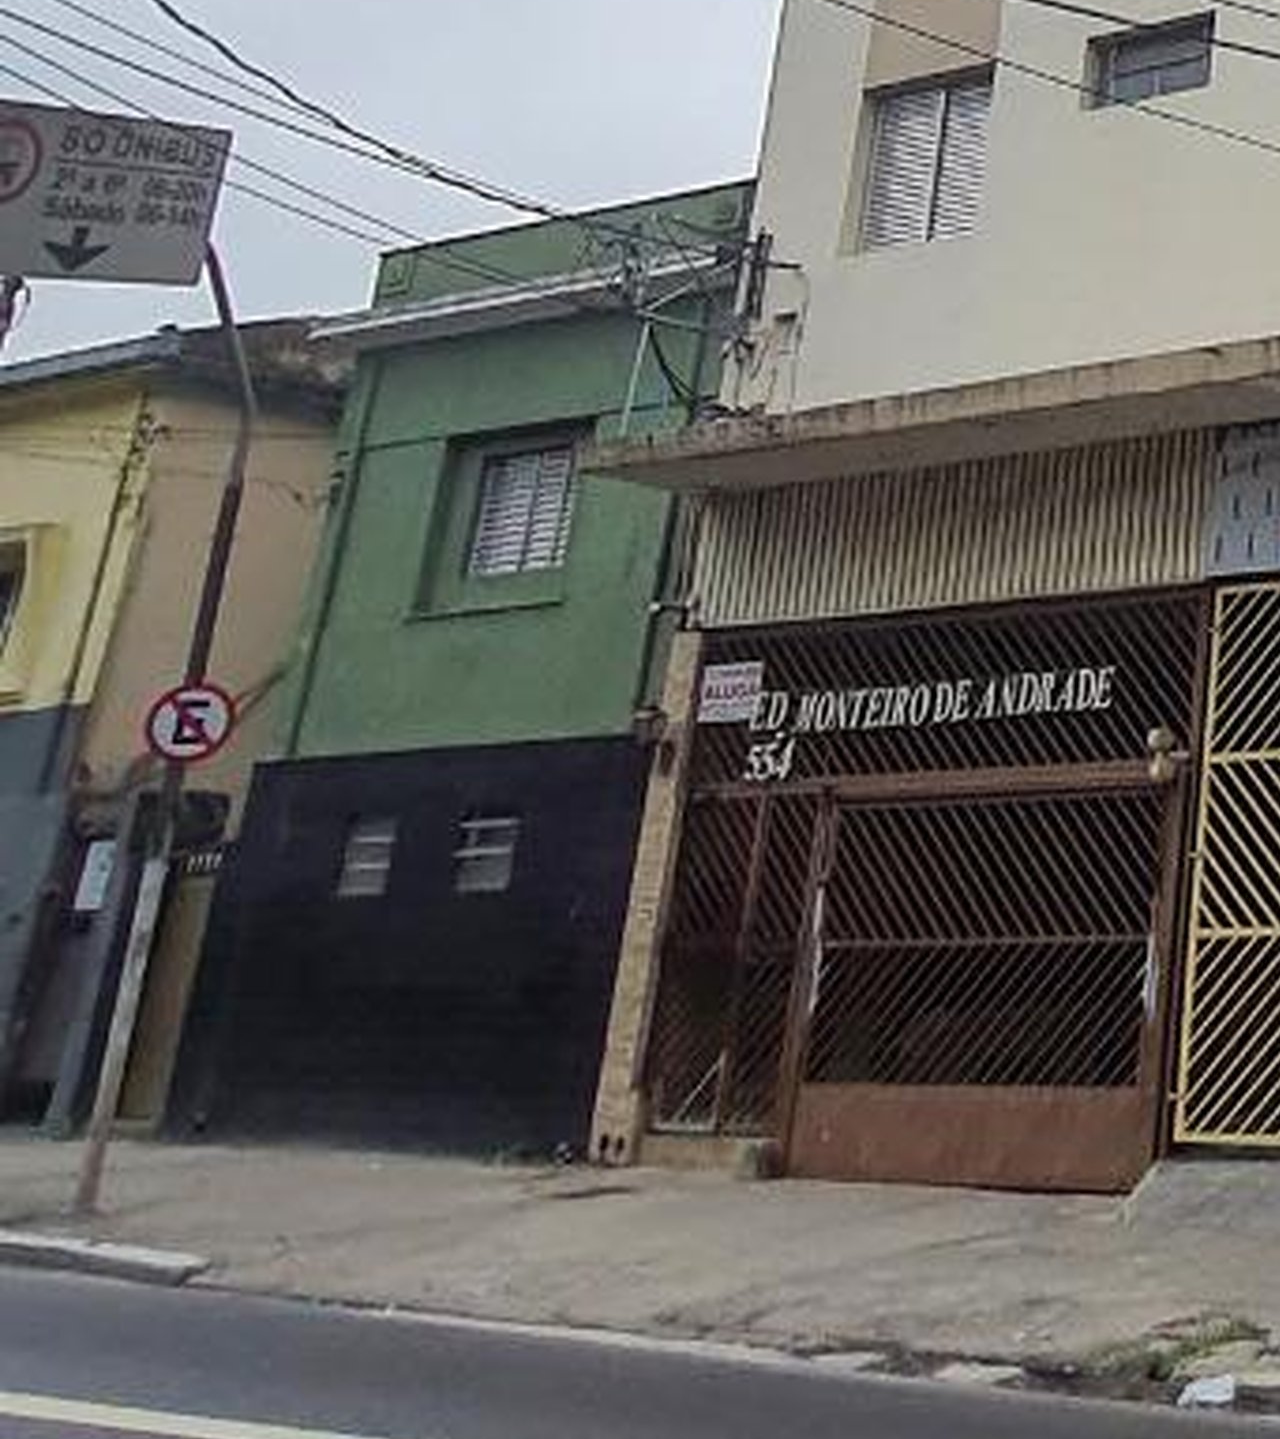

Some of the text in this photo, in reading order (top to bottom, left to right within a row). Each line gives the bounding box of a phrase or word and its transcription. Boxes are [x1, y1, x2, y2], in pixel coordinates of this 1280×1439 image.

[797, 684, 931, 732] MONTEIRO
[934, 679, 972, 723] DE
[974, 666, 1116, 719] ANDRADE
